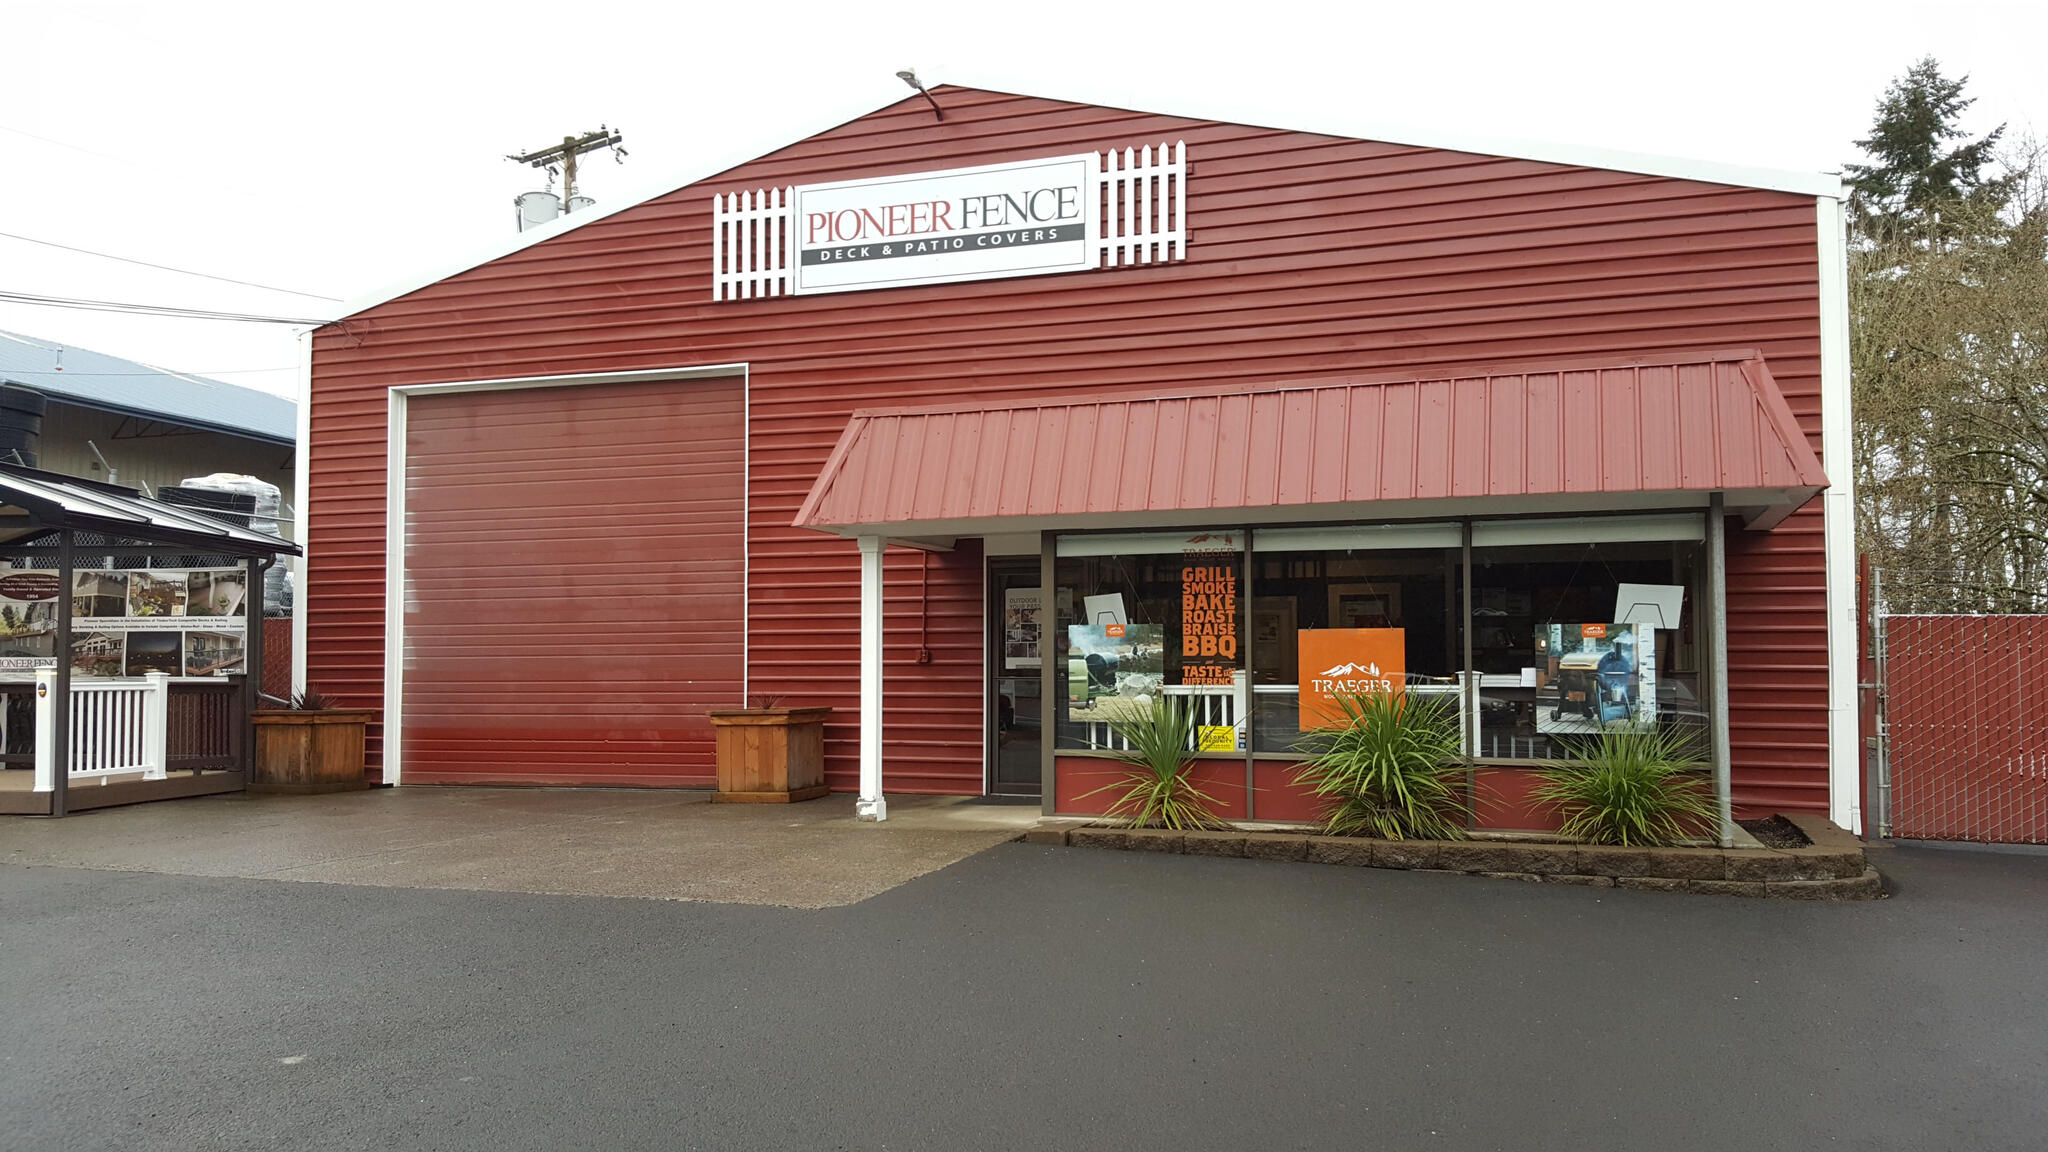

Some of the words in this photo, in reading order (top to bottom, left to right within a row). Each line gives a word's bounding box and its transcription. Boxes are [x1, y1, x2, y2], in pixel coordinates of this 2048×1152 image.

[806, 200, 956, 244] PIONEER
[960, 186, 1079, 229] FENCE
[820, 246, 870, 261] DECK
[882, 244, 892, 256] &
[905, 238, 964, 253] PATIO
[977, 228, 1058, 246] COVERS
[1182, 566, 1236, 582] GRILL
[1182, 581, 1236, 594] SMOKE
[1182, 594, 1236, 610] BAKE
[1182, 610, 1236, 623] ROAST
[1182, 623, 1236, 635] BRAISE
[1182, 635, 1237, 660] BBQ
[0, 659, 33, 667] IONEER
[1182, 665, 1223, 677] TASTE
[1311, 679, 1392, 692] TRAEGER
